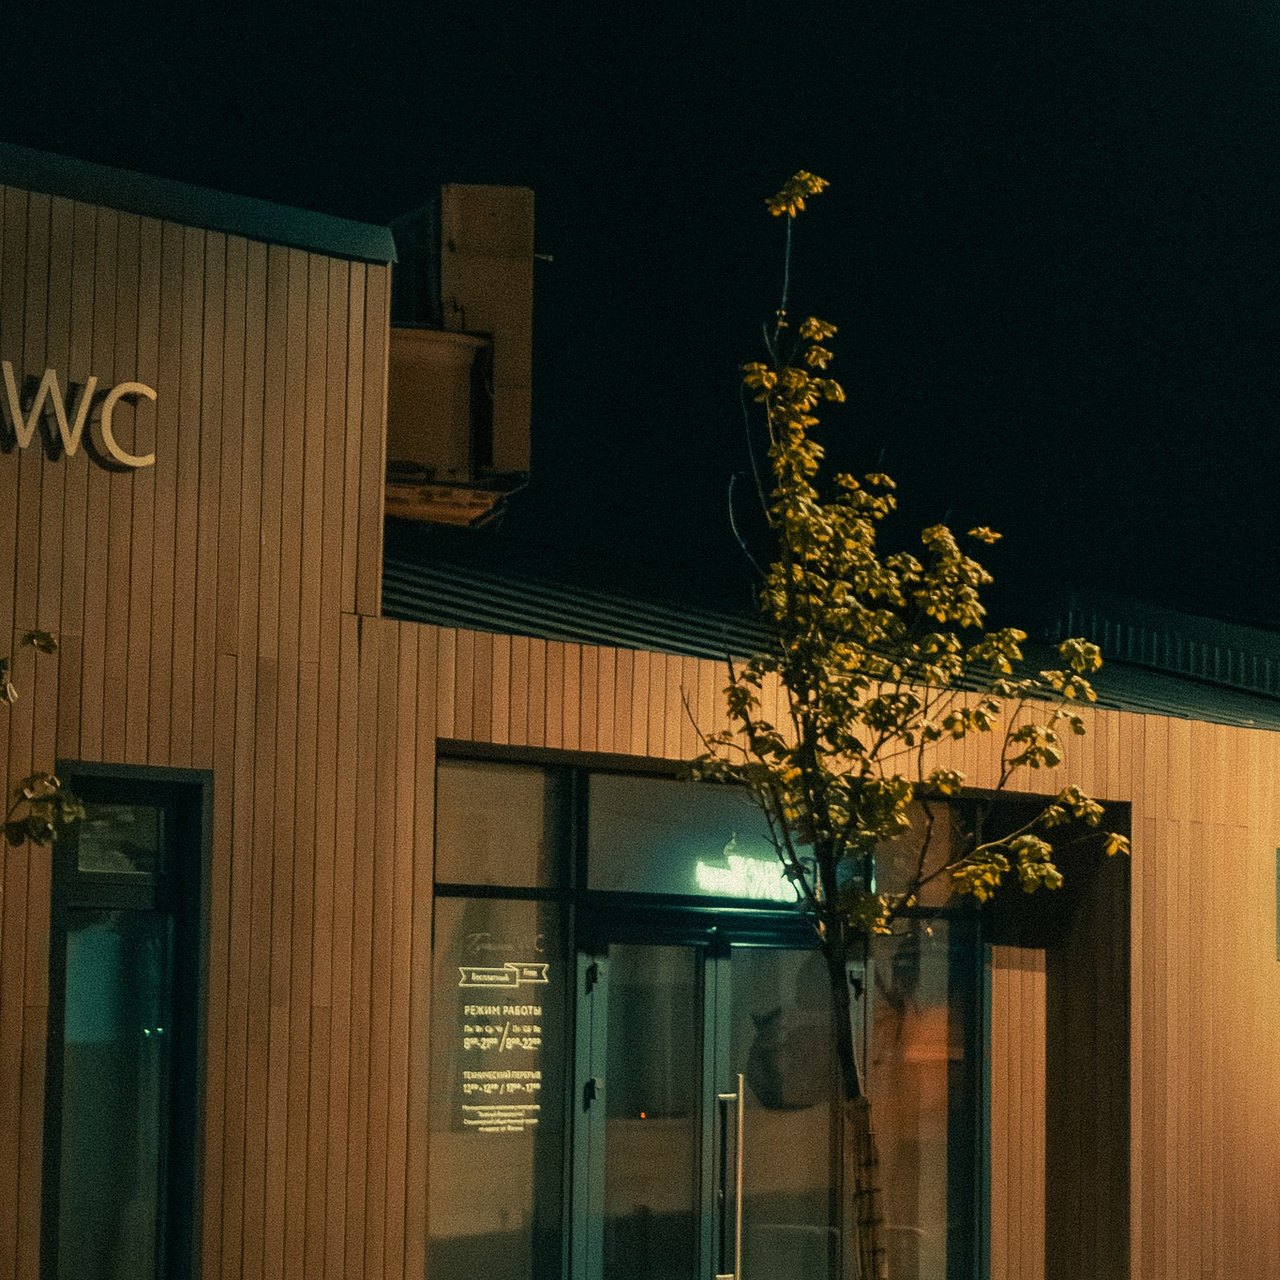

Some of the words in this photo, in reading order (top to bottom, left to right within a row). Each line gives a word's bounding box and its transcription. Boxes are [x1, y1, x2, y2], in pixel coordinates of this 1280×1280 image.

[2, 360, 158, 468] WC
[464, 1005, 501, 1016] РЕЖИМ
[502, 1005, 543, 1016] РАБОТЫ
